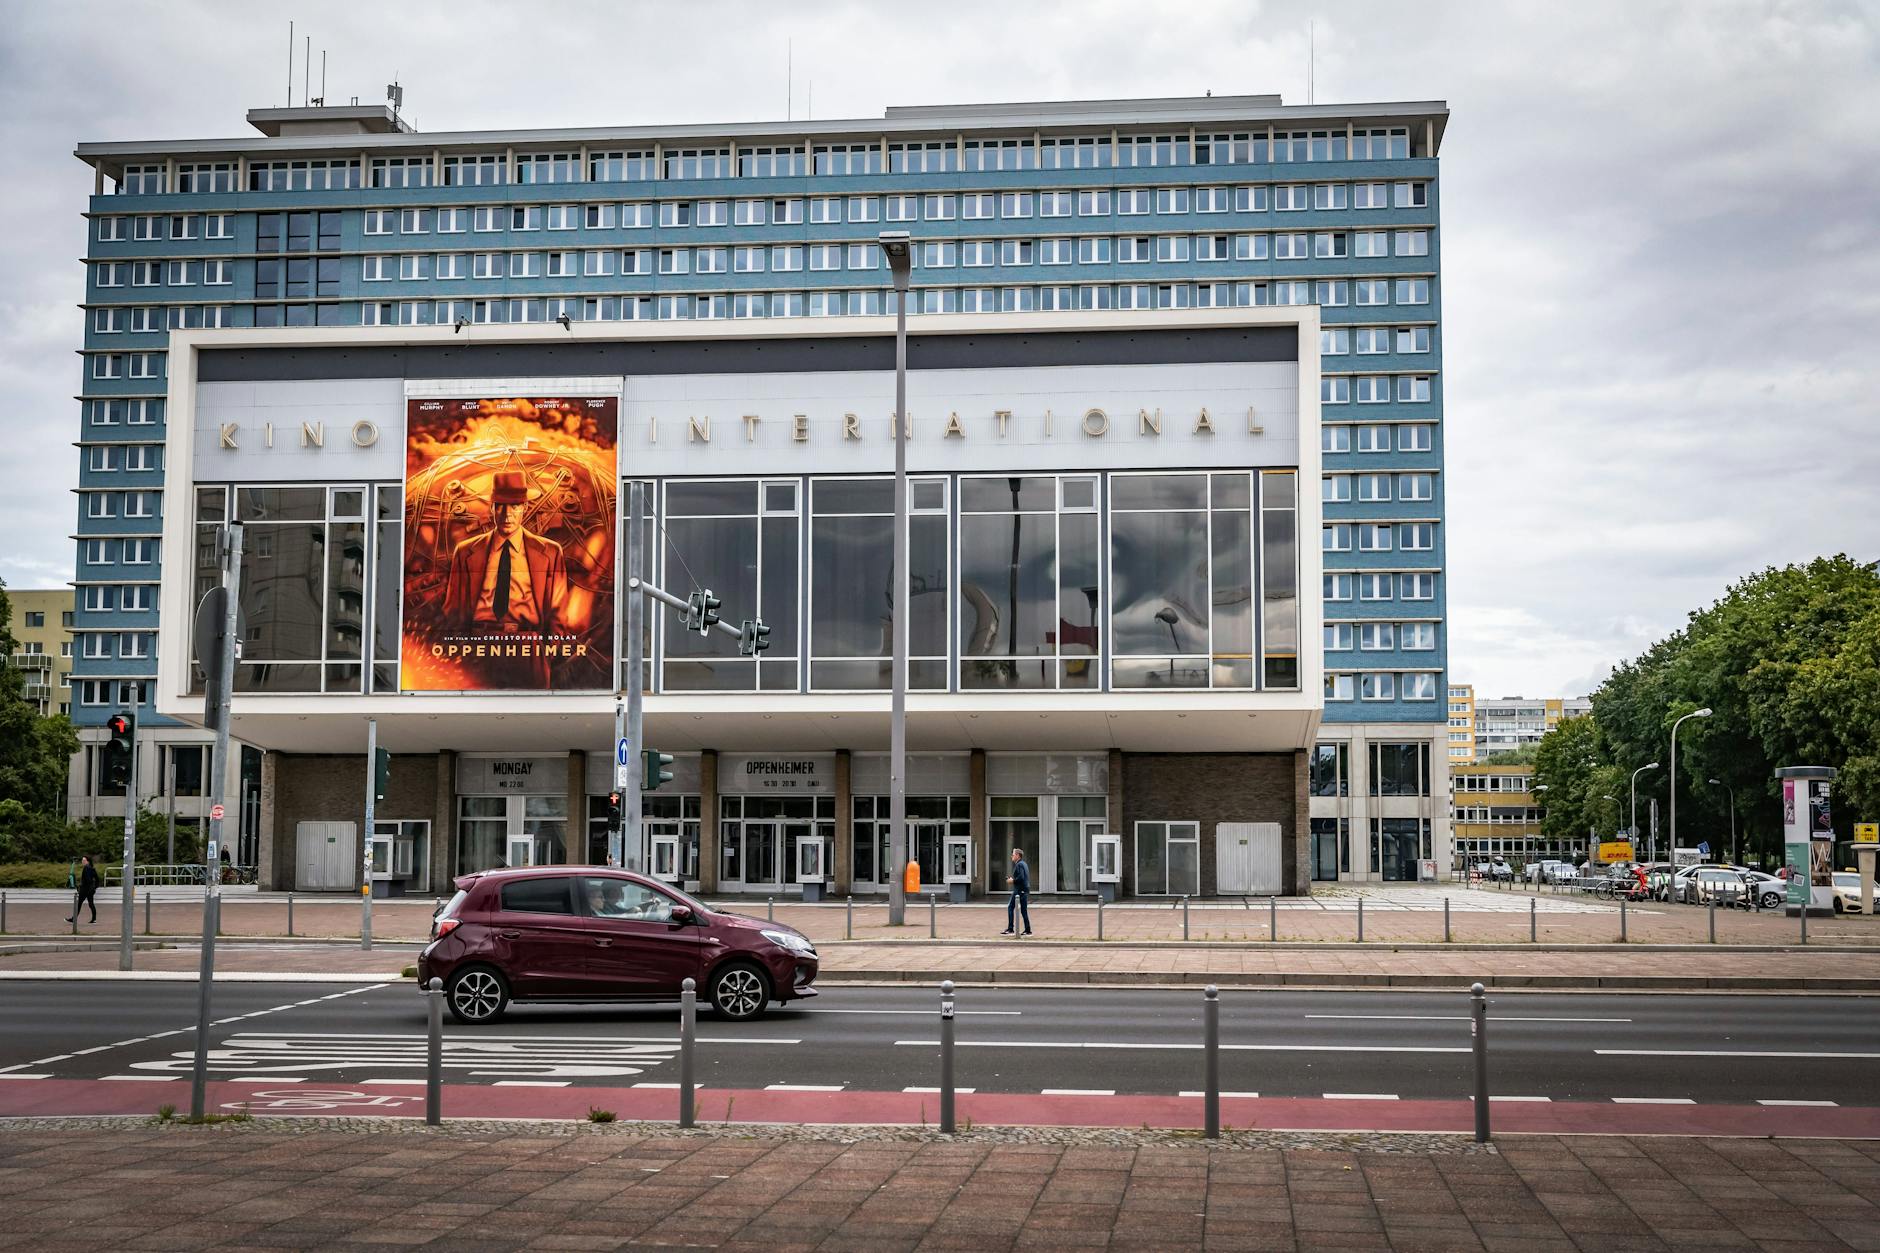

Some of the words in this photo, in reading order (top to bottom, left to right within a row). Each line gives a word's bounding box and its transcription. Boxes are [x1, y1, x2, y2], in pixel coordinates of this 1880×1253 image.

[218, 419, 379, 449] KINO
[648, 404, 1266, 443] INTERNATIONAL
[431, 644, 588, 657] OPPENHEIMER
[493, 762, 533, 775] MONGAY
[746, 761, 815, 774] OPPENHEIMER
